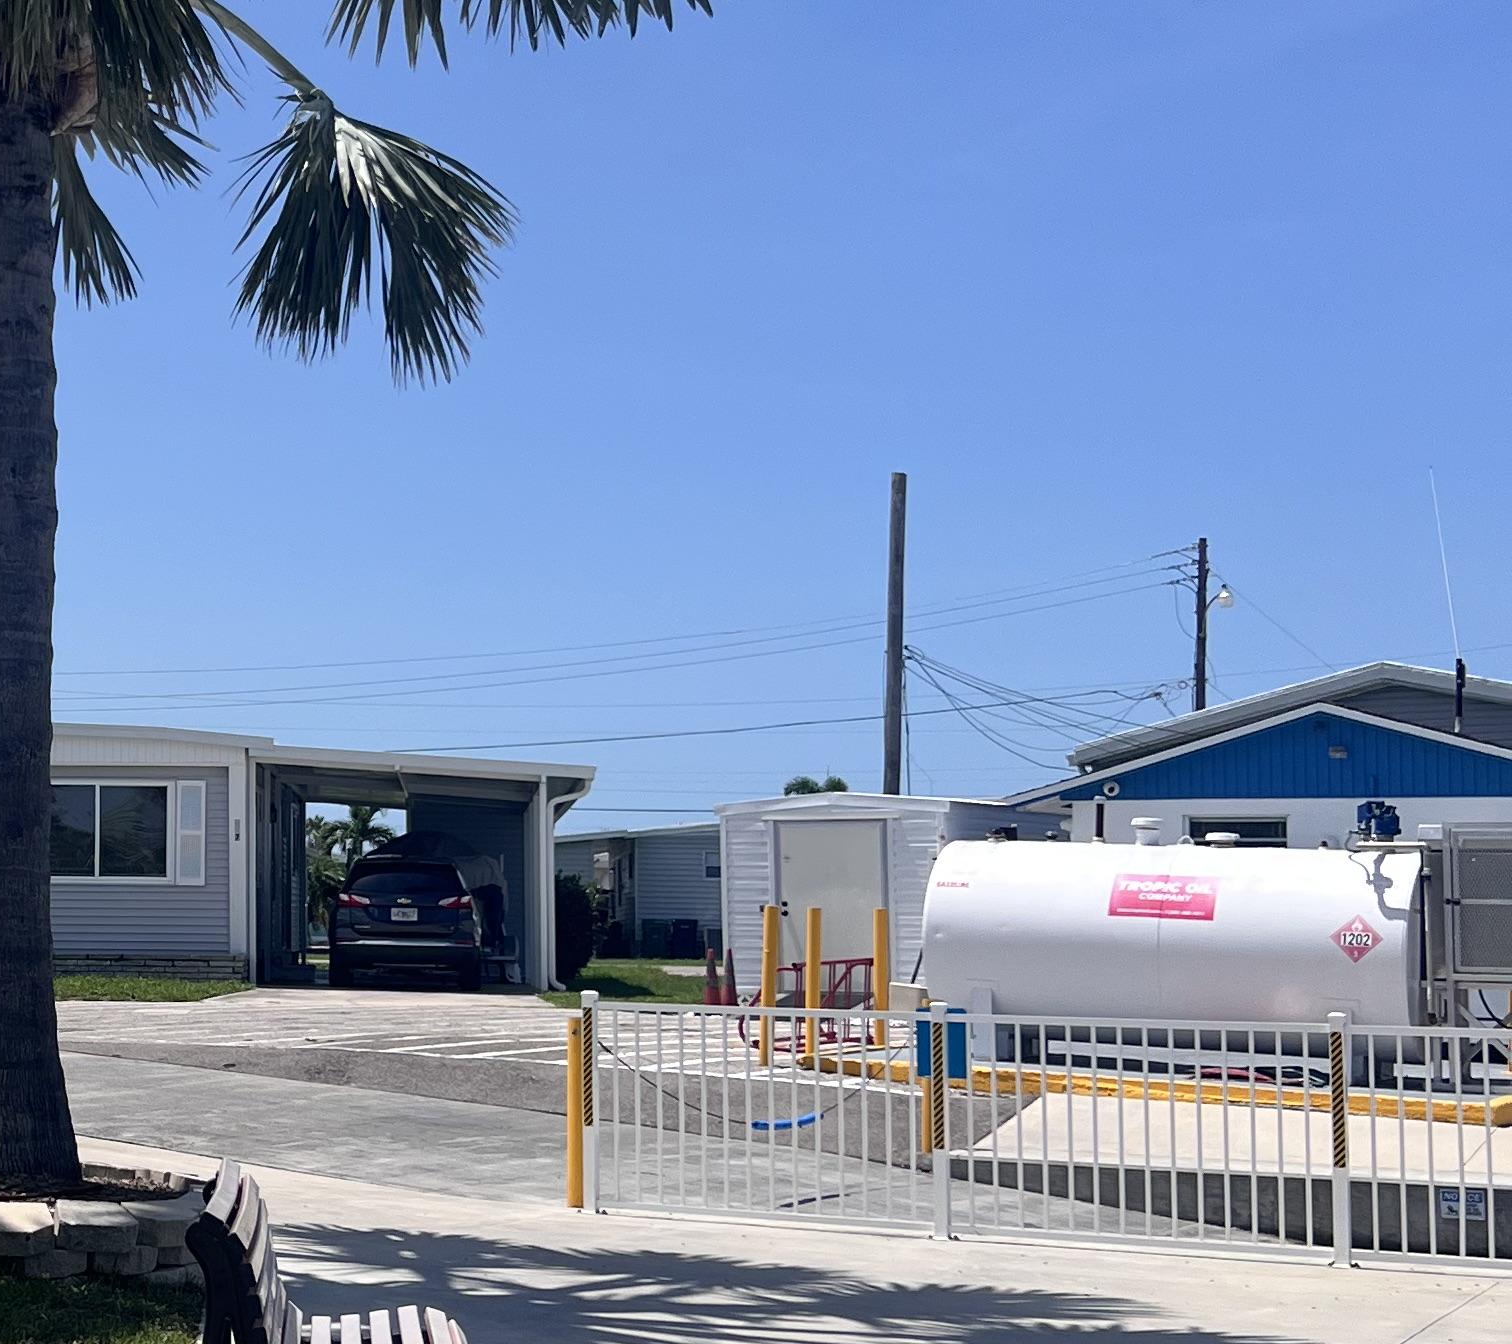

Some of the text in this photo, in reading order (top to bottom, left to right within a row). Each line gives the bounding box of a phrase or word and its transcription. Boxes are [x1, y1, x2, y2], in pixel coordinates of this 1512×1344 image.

[1119, 881, 1213, 894] TROPIC OIL
[1138, 893, 1193, 902] COMPANY
[1342, 932, 1370, 946] 1202
[1443, 1192, 1481, 1202] NOCE
